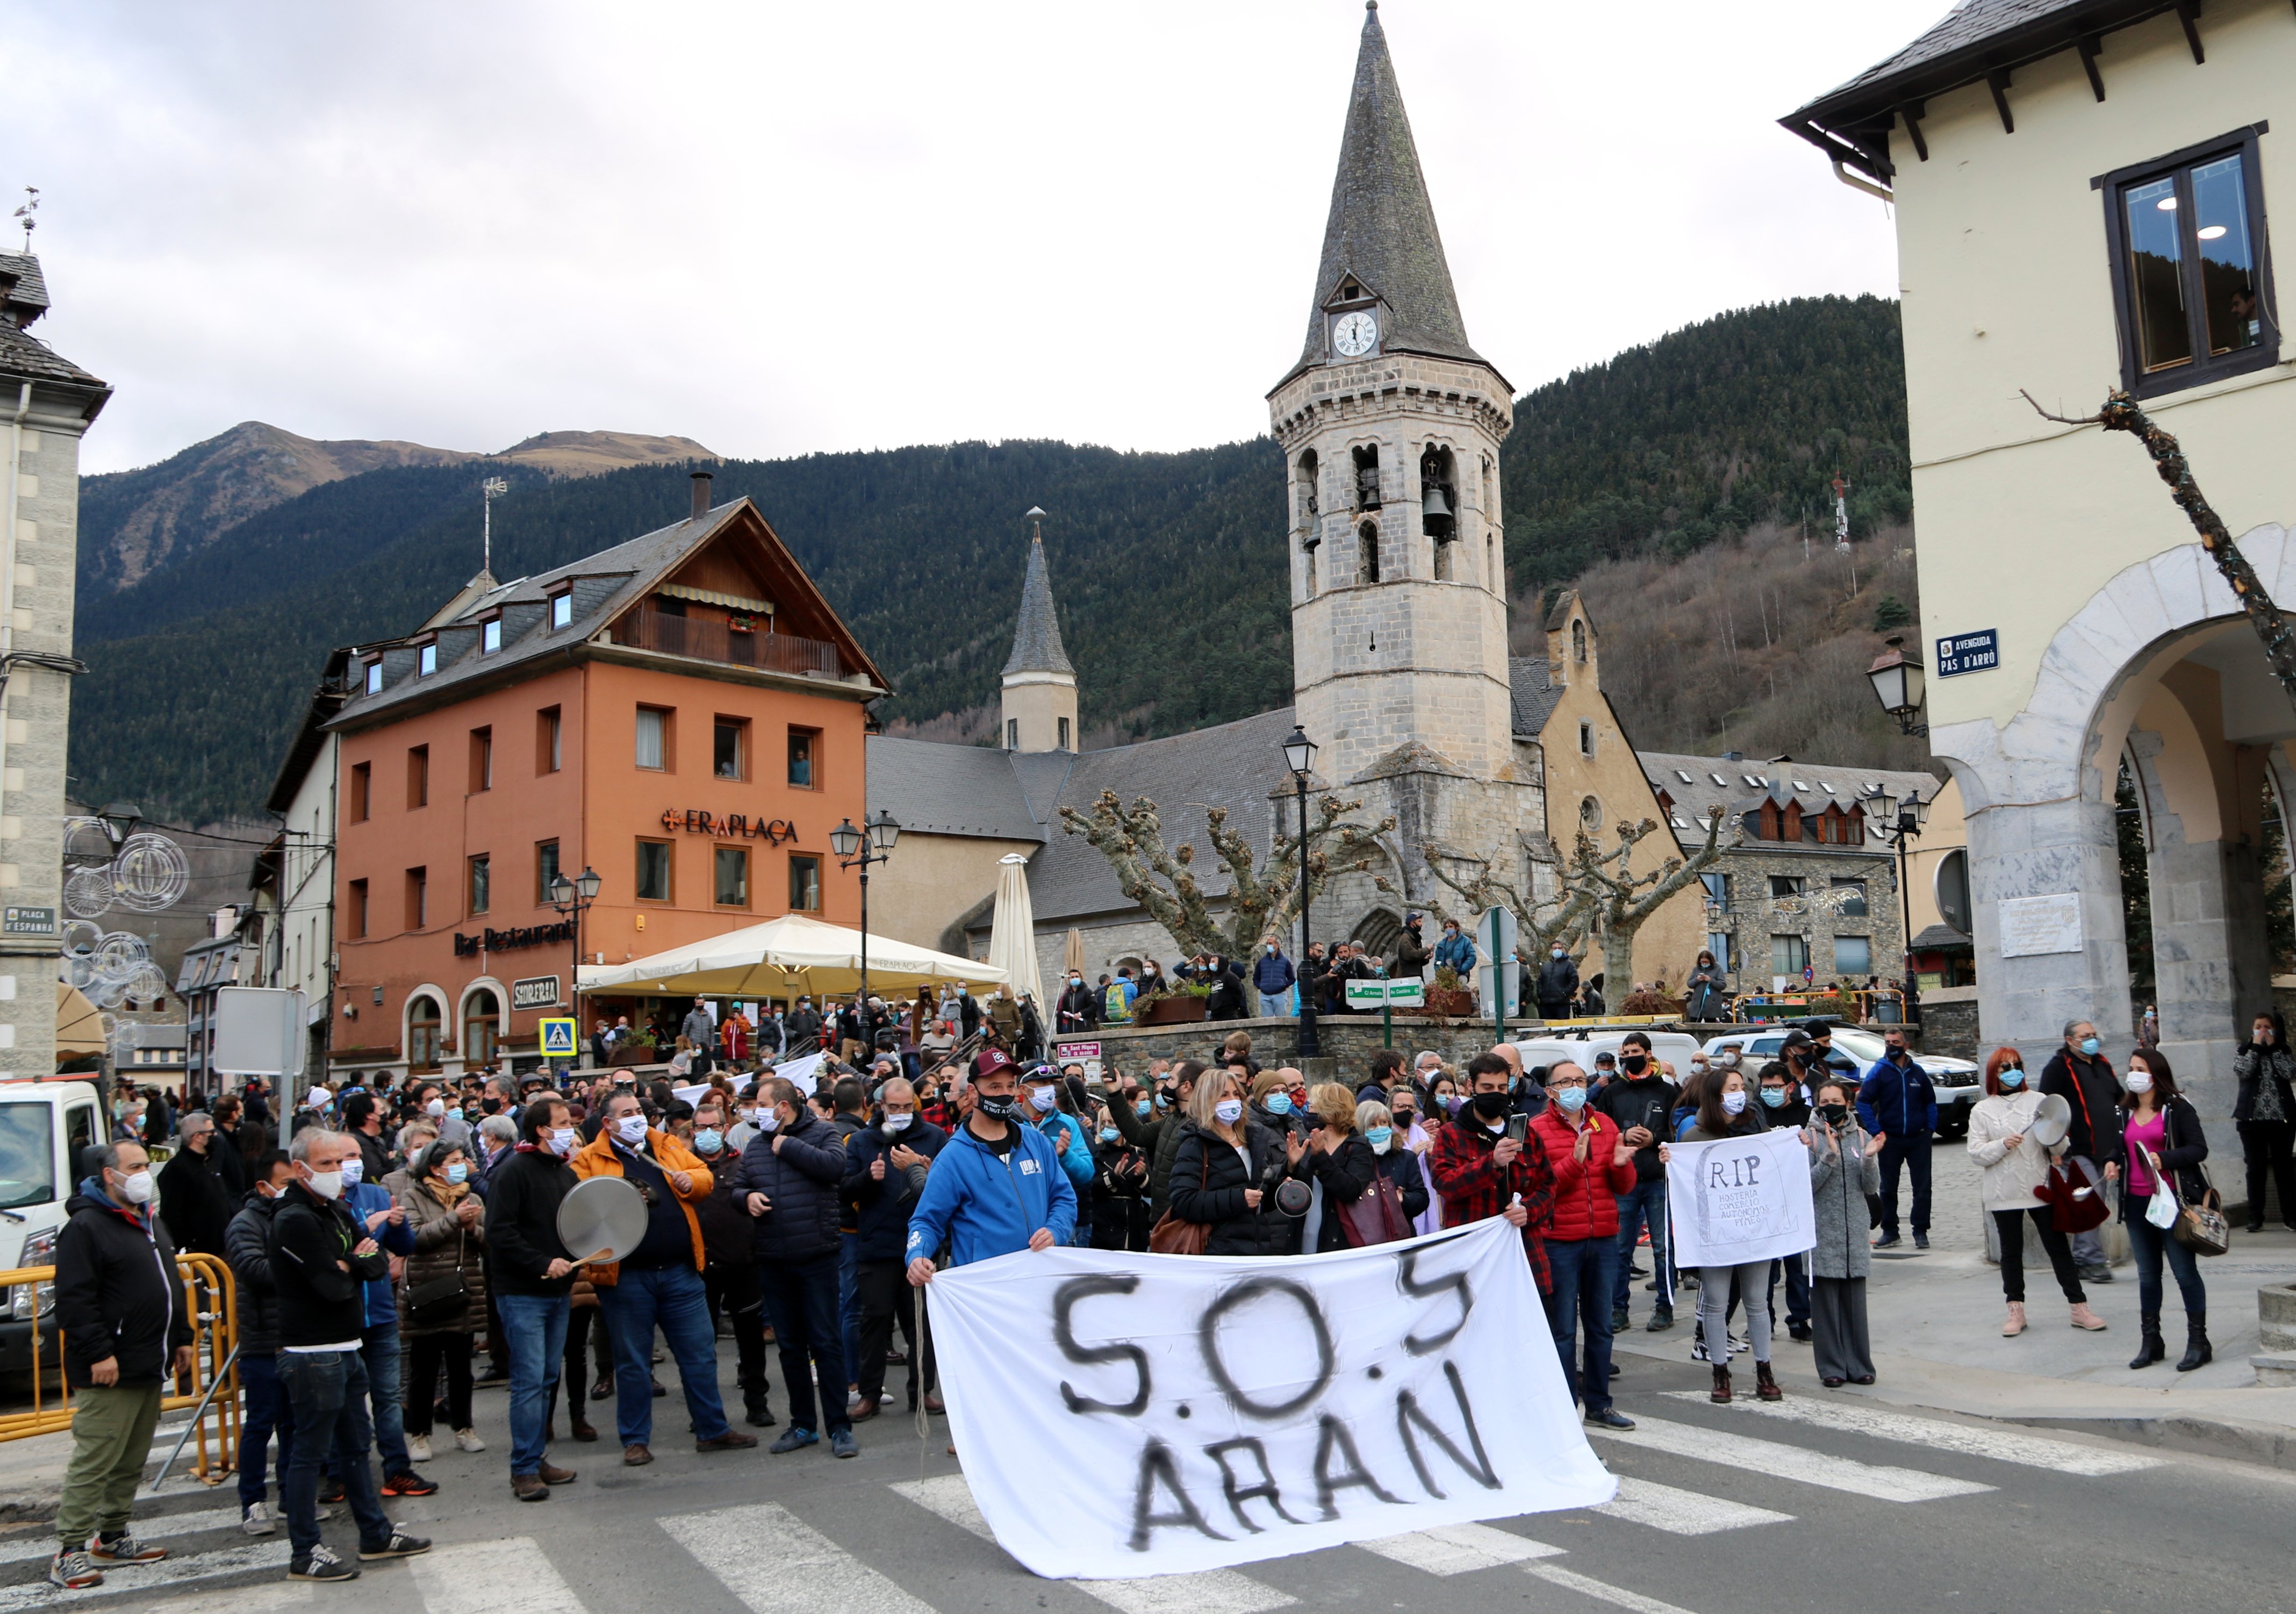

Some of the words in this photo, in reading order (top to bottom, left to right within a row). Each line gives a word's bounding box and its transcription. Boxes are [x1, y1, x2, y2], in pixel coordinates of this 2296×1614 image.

[1955, 636, 1991, 651] AVENGUDA
[1941, 658, 1957, 672] PAS
[1964, 649, 1994, 668] D'ARRÒ
[454, 932, 480, 956] Bar
[484, 919, 575, 952] Restaurant
[1710, 1155, 1761, 1189] RIP
[1719, 1197, 1760, 1210] COMERCIO
[1734, 1214, 1761, 1226] PYMES
[1127, 1360, 1504, 1552] ARAN
